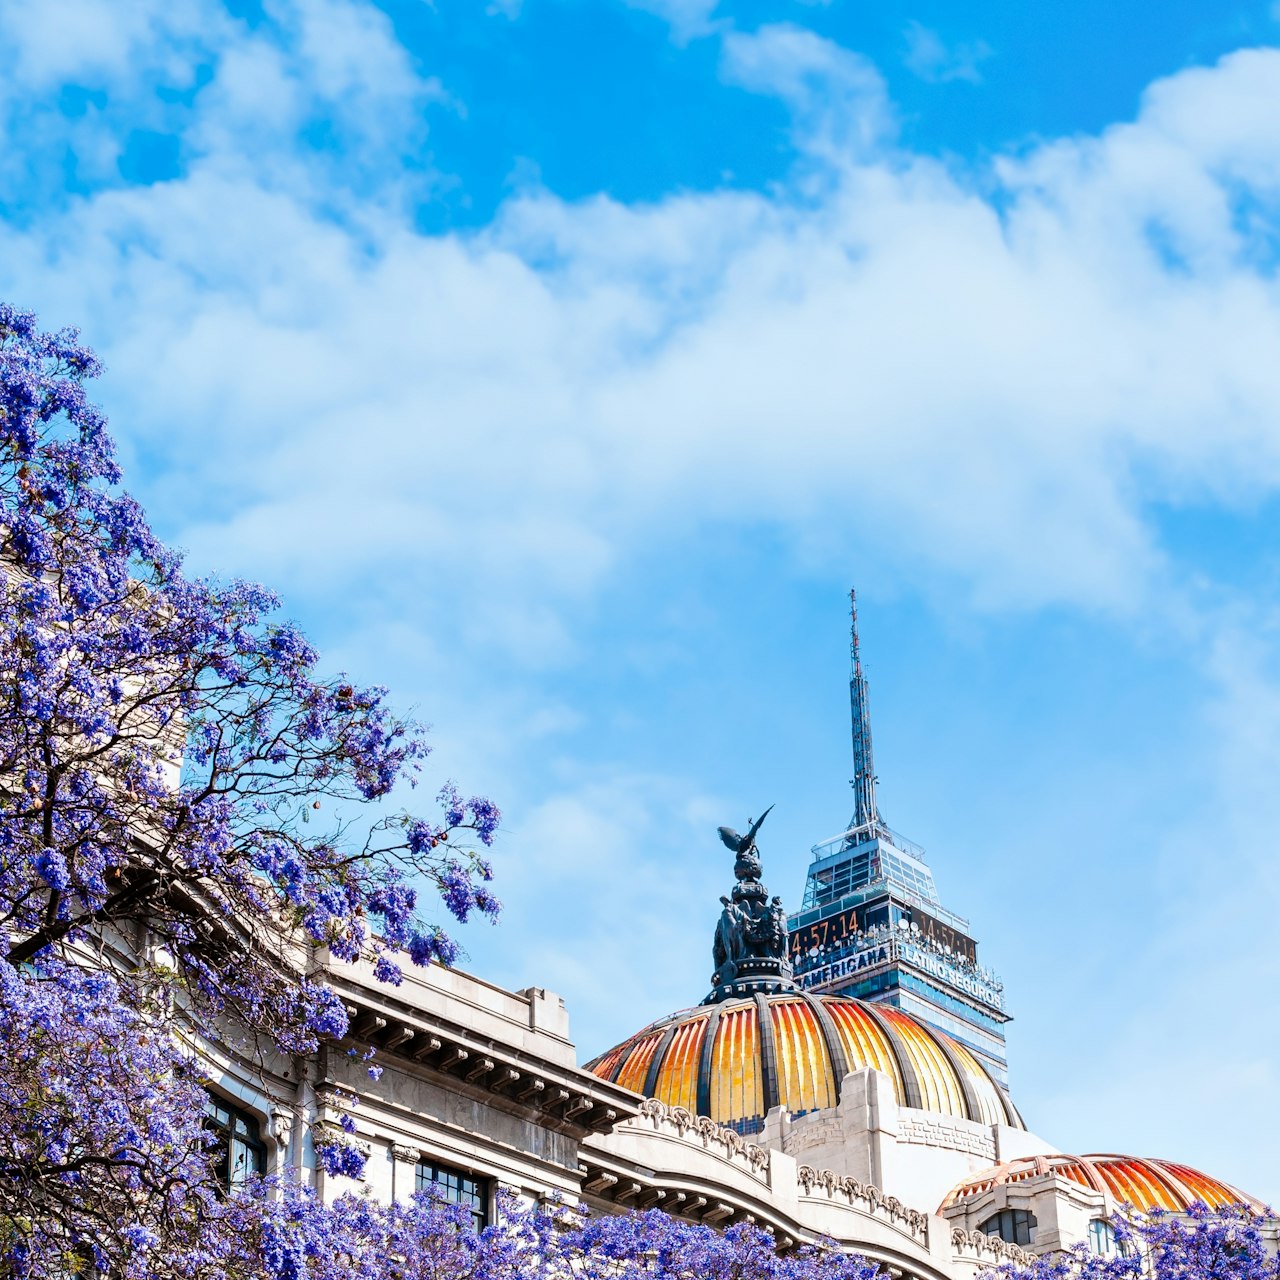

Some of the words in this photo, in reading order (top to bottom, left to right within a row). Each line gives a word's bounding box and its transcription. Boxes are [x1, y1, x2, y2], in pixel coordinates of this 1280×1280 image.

[789, 911, 858, 958] 4:57:14
[795, 946, 887, 990] AMERICANA
[905, 947, 946, 978] LATINO
[948, 969, 1002, 1008] SEGUROS
